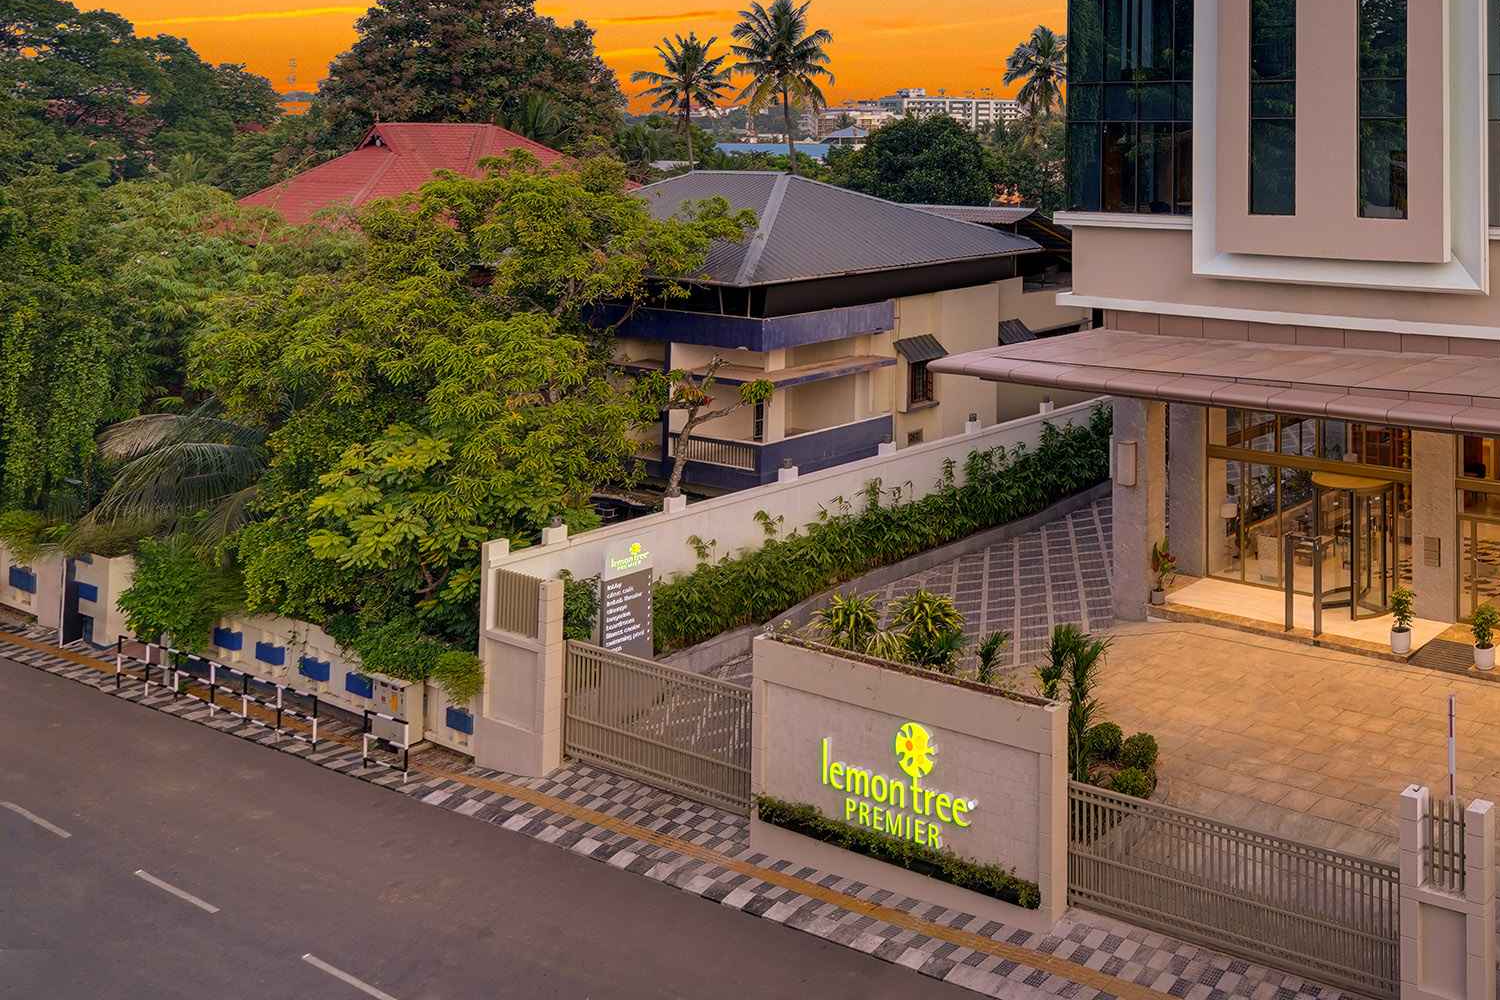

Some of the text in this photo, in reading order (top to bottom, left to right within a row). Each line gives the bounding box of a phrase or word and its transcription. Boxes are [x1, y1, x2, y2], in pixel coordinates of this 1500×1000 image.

[822, 737, 971, 827] lemon tree
[845, 797, 940, 849] PREMIER
